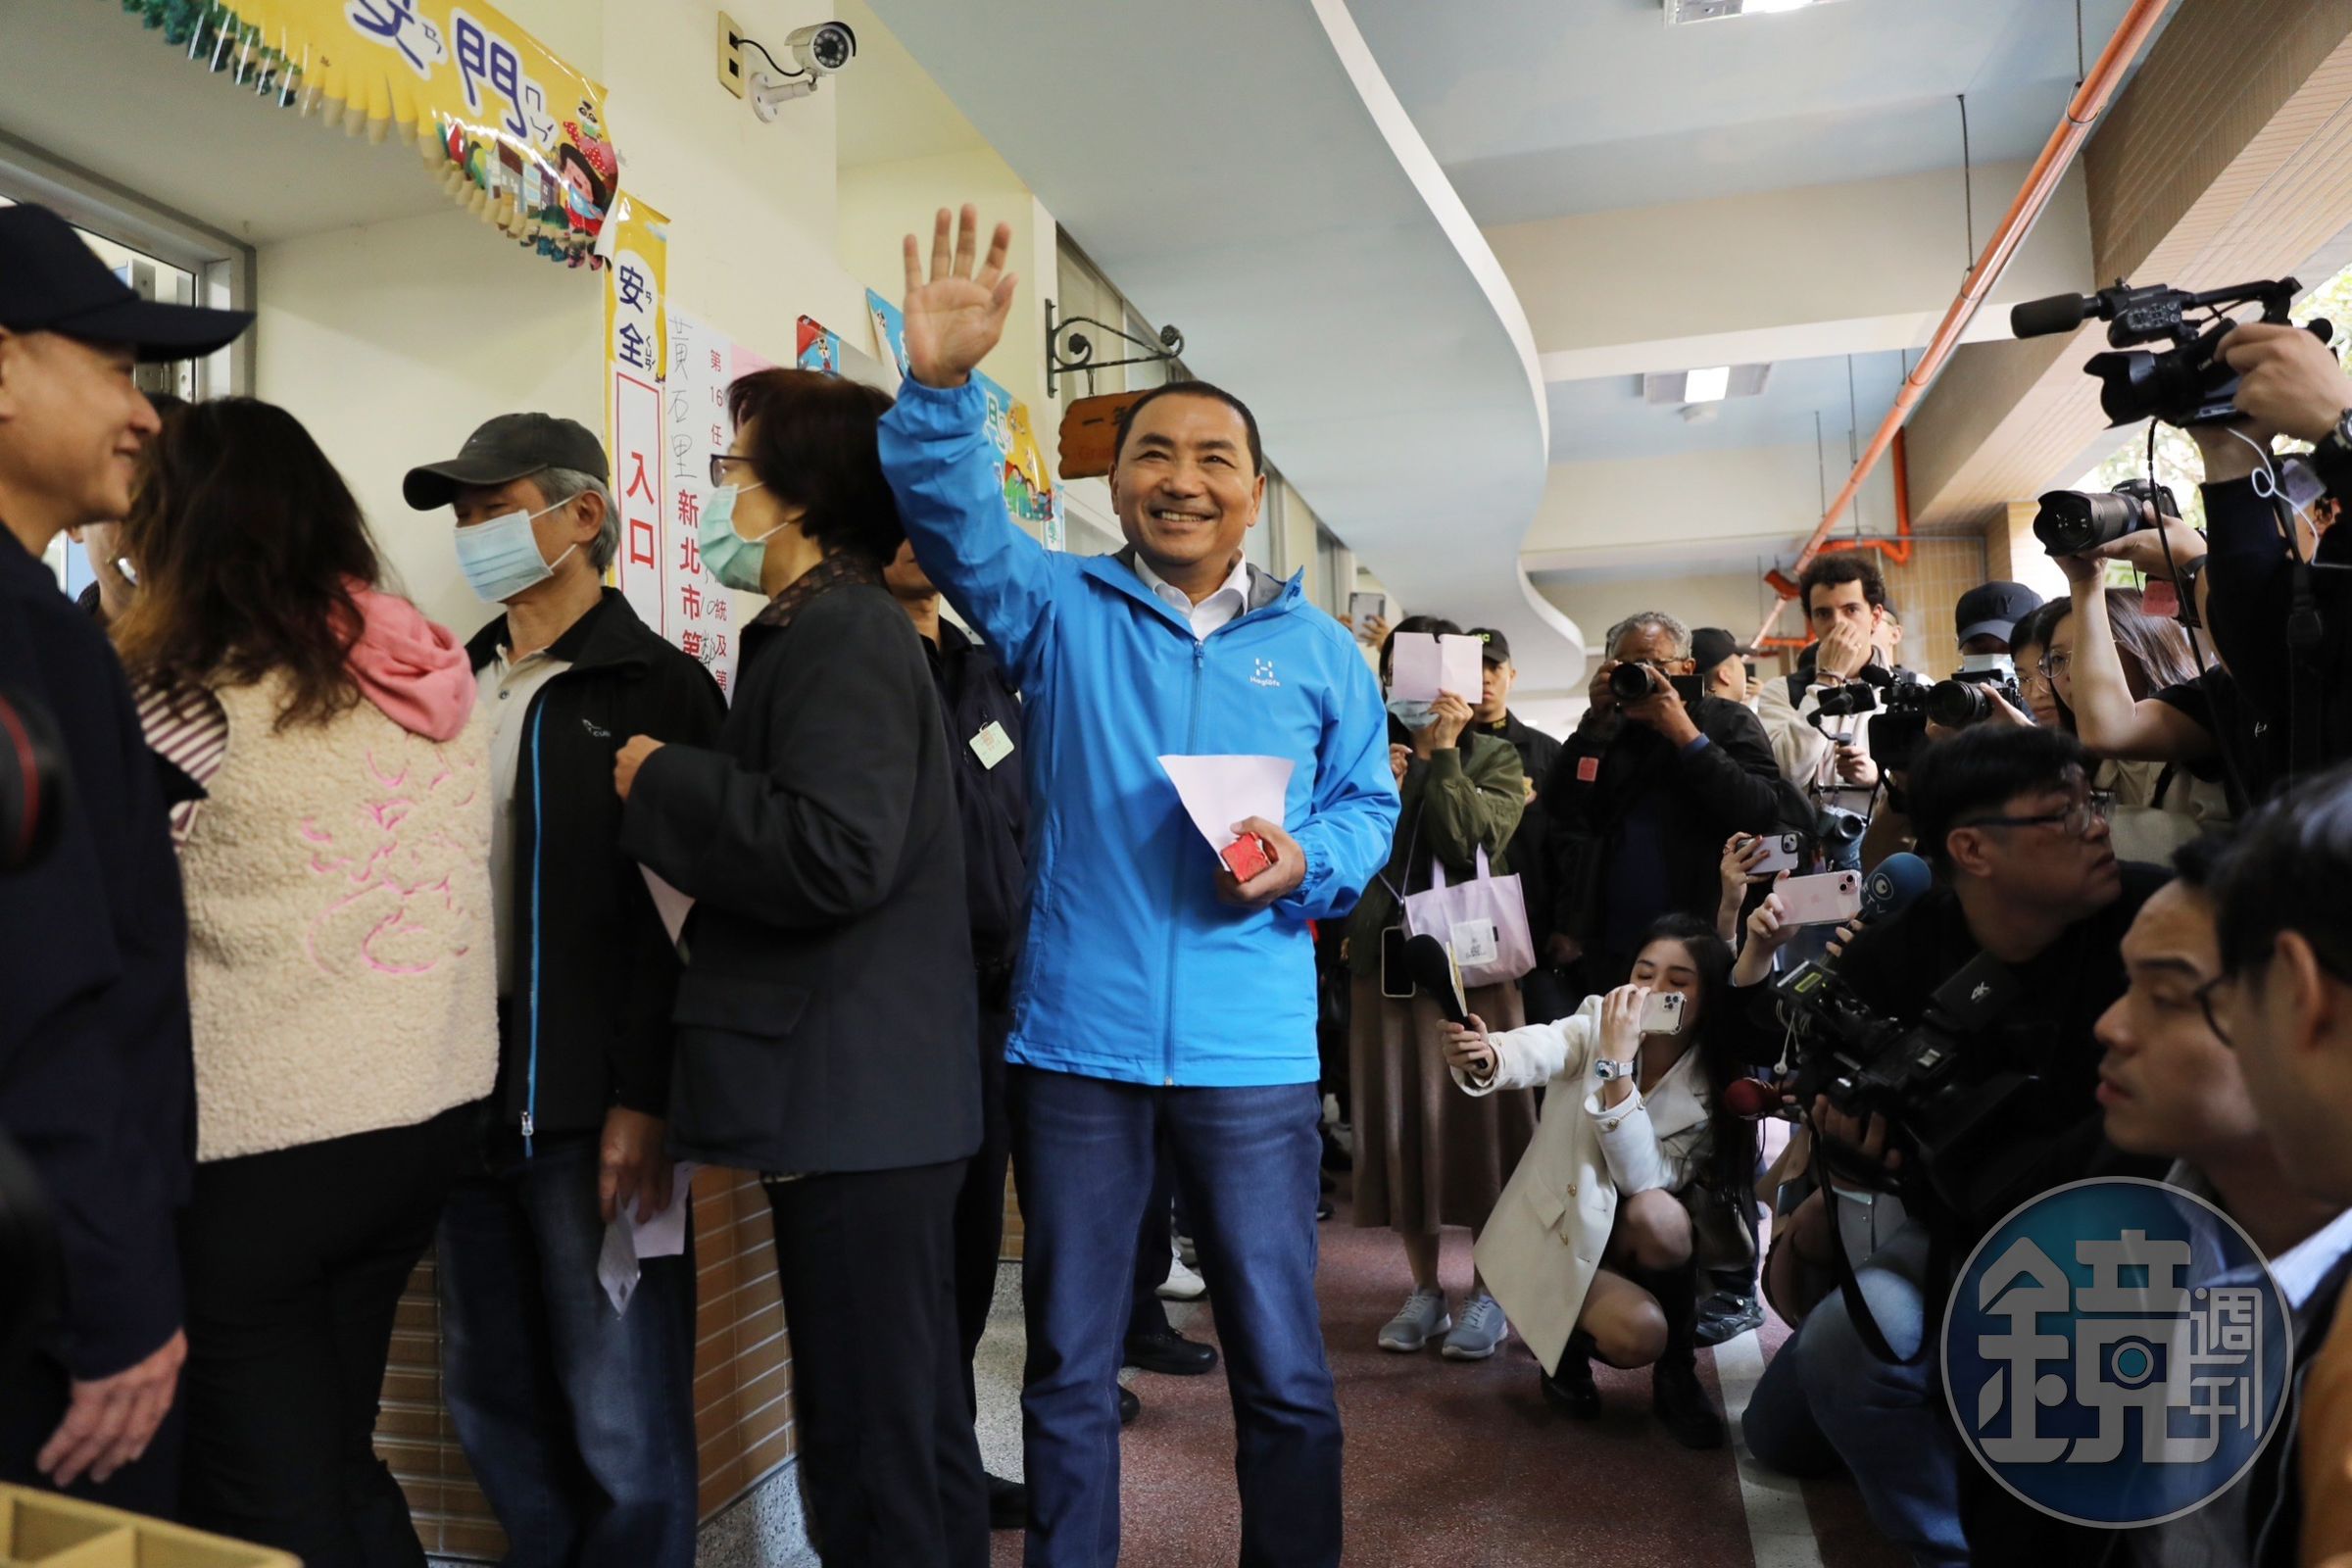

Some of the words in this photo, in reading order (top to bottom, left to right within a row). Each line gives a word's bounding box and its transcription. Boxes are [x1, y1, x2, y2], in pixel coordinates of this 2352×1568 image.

[618, 265, 645, 369] 安全
[626, 451, 656, 570] 入口
[678, 489, 702, 660] 新北市第
